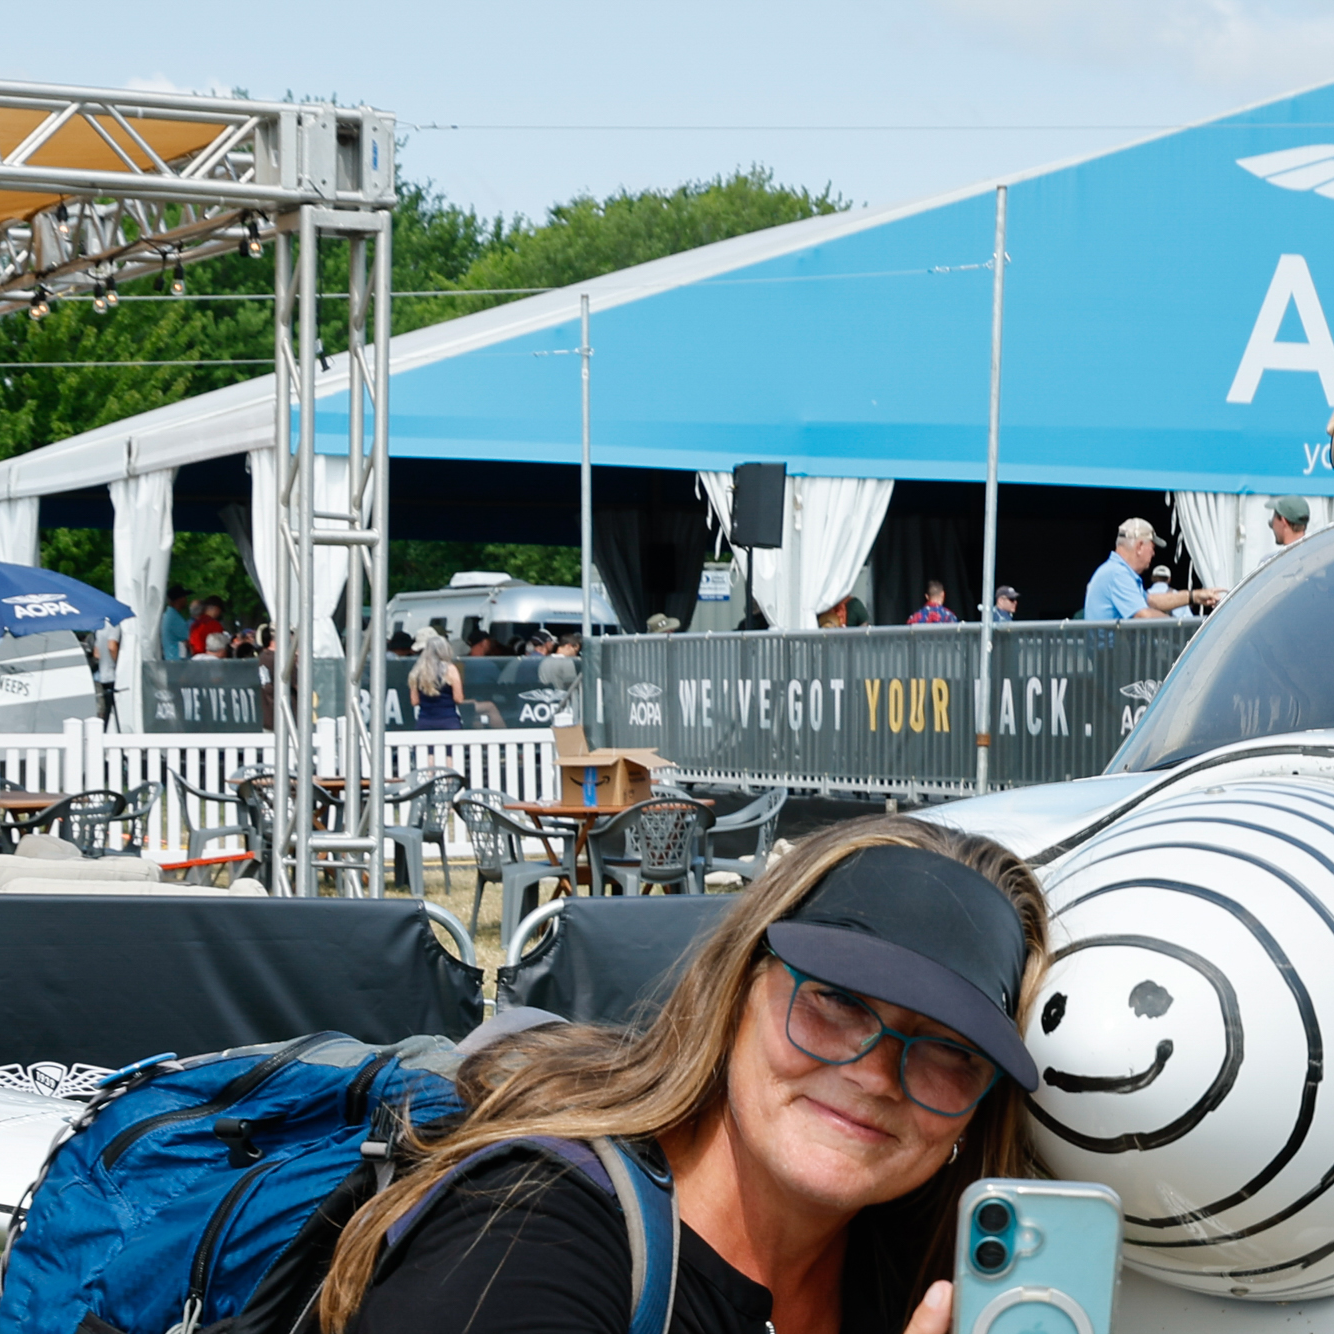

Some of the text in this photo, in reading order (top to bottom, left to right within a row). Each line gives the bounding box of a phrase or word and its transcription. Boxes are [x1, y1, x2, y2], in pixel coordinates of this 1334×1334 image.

[14, 601, 80, 620] AOPA
[230, 688, 257, 724] GOT
[629, 702, 663, 727] AOPA
[787, 679, 845, 732] GOT
[865, 678, 951, 734] YOUR
